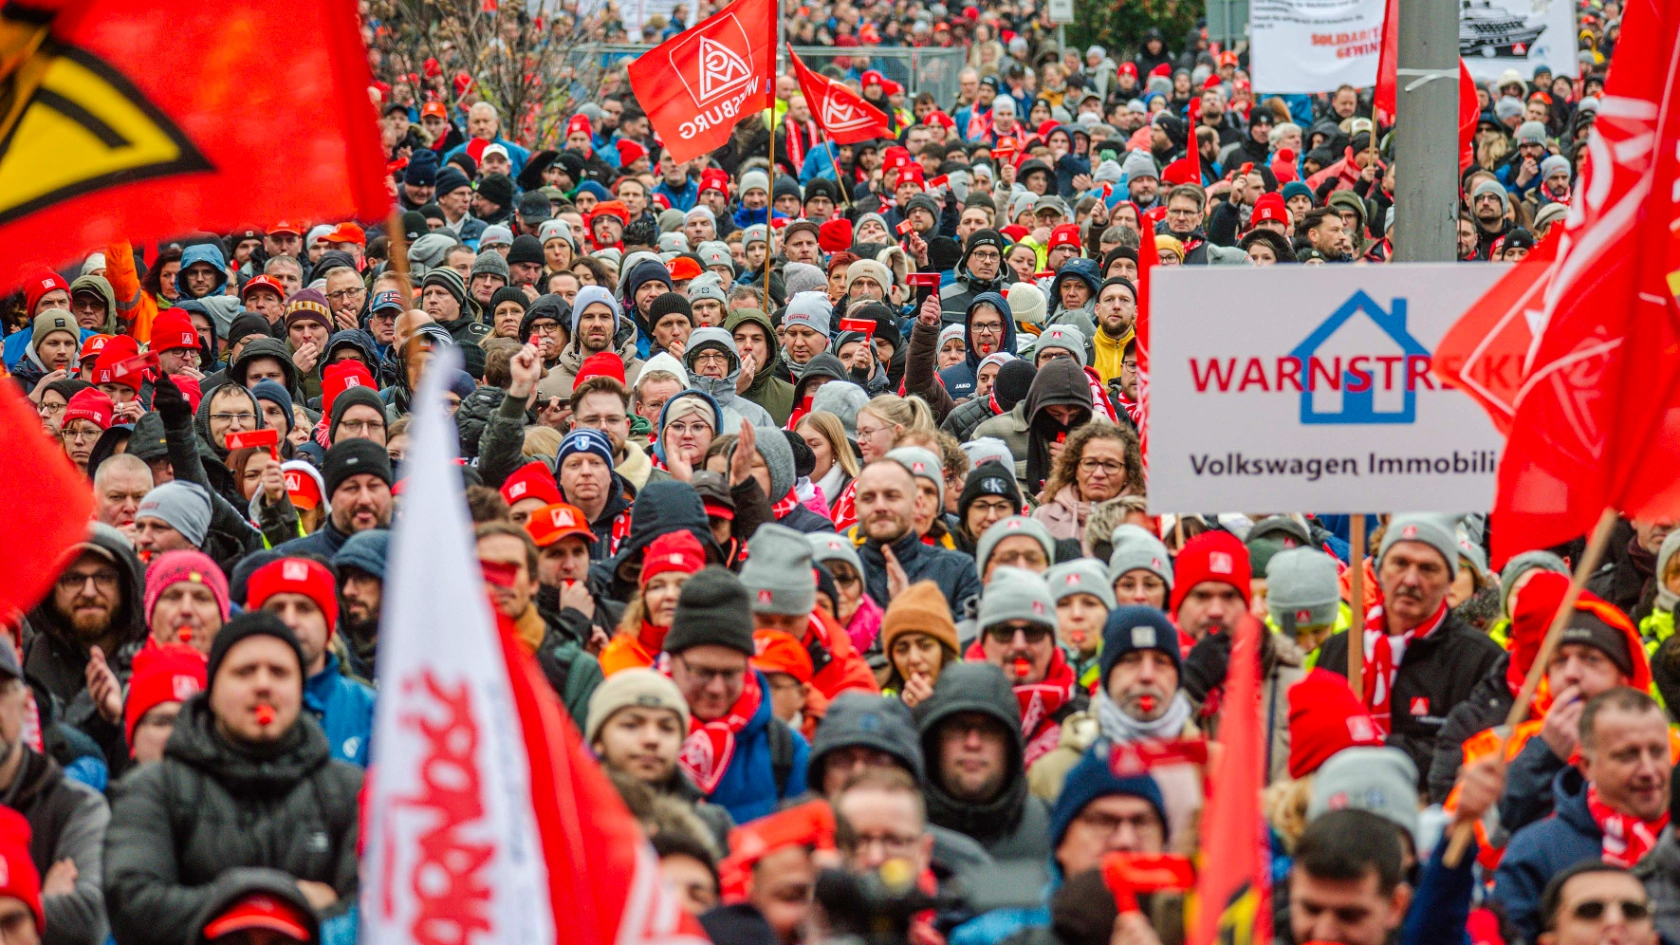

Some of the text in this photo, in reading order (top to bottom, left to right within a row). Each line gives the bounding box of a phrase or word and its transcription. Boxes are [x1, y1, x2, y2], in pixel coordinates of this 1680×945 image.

[1311, 27, 1382, 47] SOLIDARIT
[1336, 43, 1381, 59] GEWIN
[1189, 450, 1497, 481] Volkswagen Immobili
